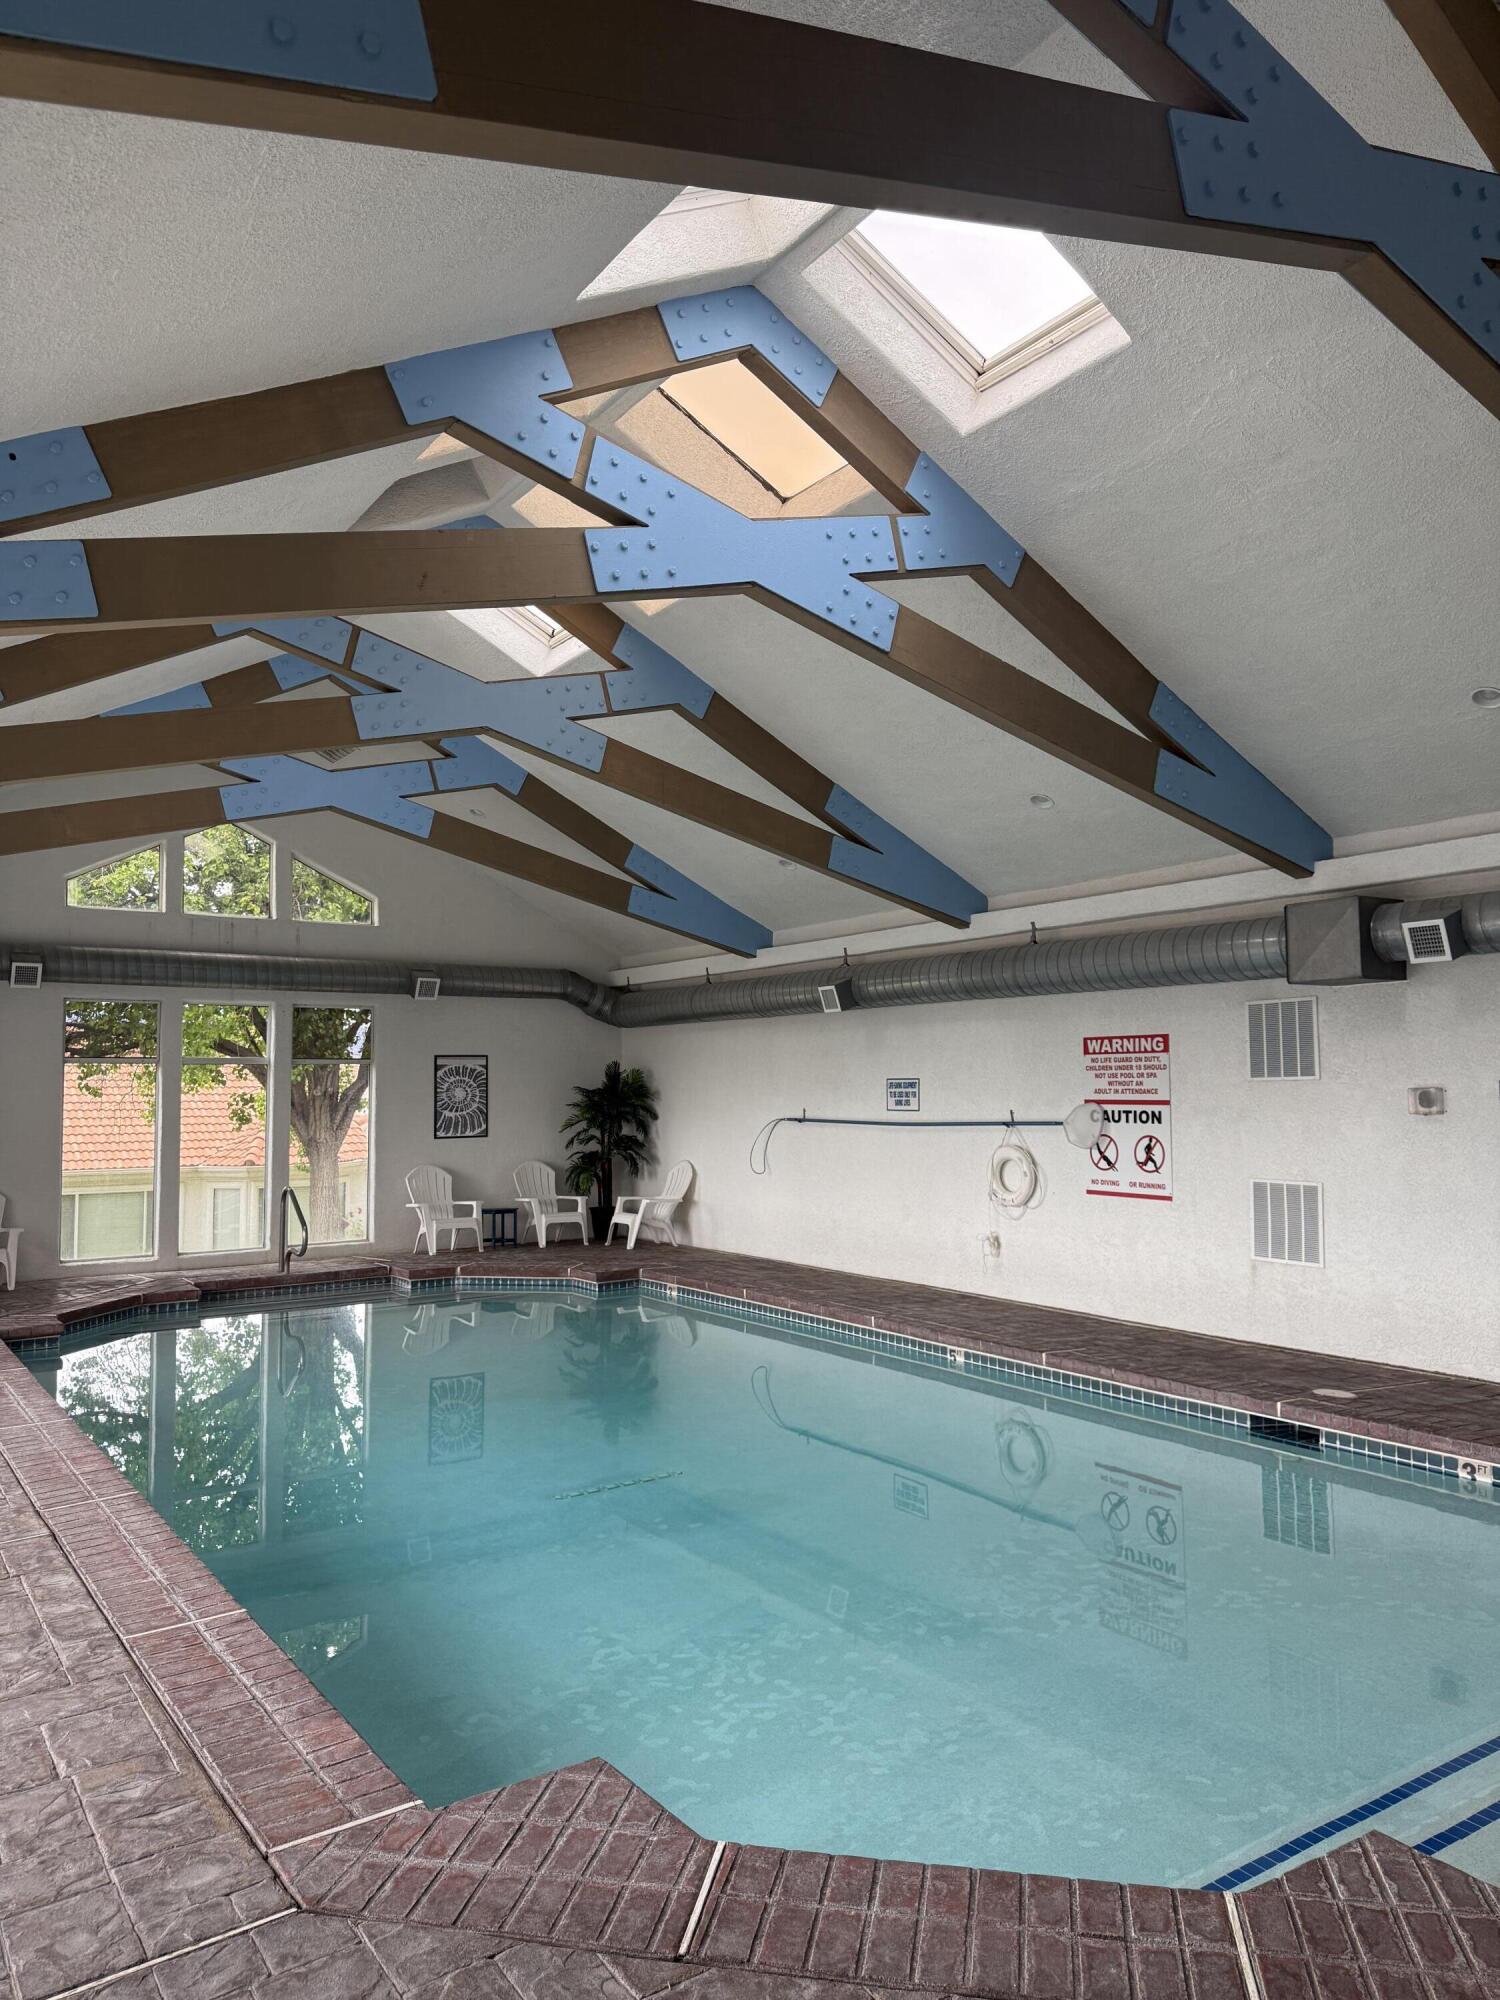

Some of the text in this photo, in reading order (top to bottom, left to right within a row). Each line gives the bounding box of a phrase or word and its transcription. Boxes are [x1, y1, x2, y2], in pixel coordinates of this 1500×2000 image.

[1087, 1037, 1165, 1053] WARNING
[1090, 1109, 1162, 1124] CAUTION
[1100, 1179, 1120, 1187] DIVING
[1138, 1182, 1166, 1190] RUNNING
[1462, 1462, 1488, 1481] 3 FT
